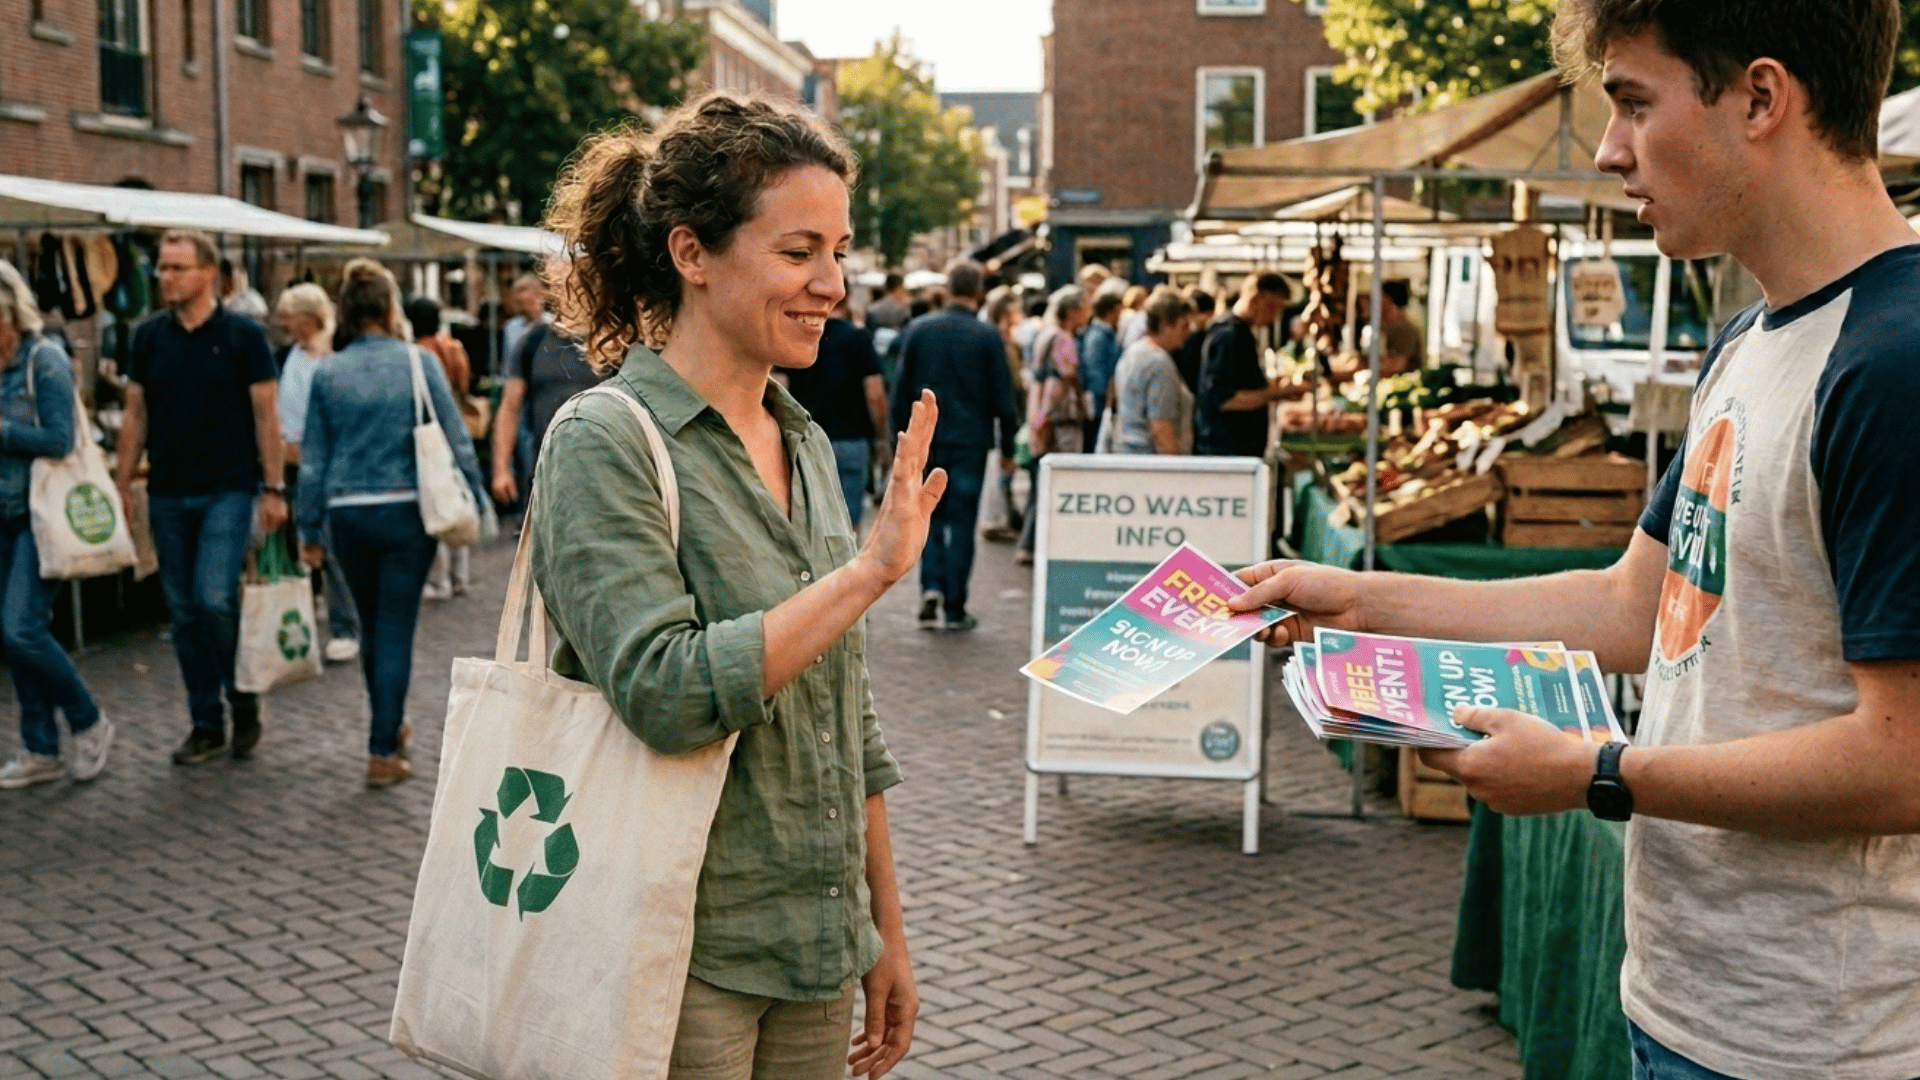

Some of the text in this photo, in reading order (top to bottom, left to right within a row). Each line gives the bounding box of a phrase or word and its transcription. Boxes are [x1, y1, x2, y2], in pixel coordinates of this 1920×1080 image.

[1057, 493, 1247, 517] ZERO WASTE
[1116, 526, 1186, 547] INFO
[1163, 645, 1197, 661] UP
[1438, 650, 1465, 680] UP
[1469, 667, 1499, 709] OW!
